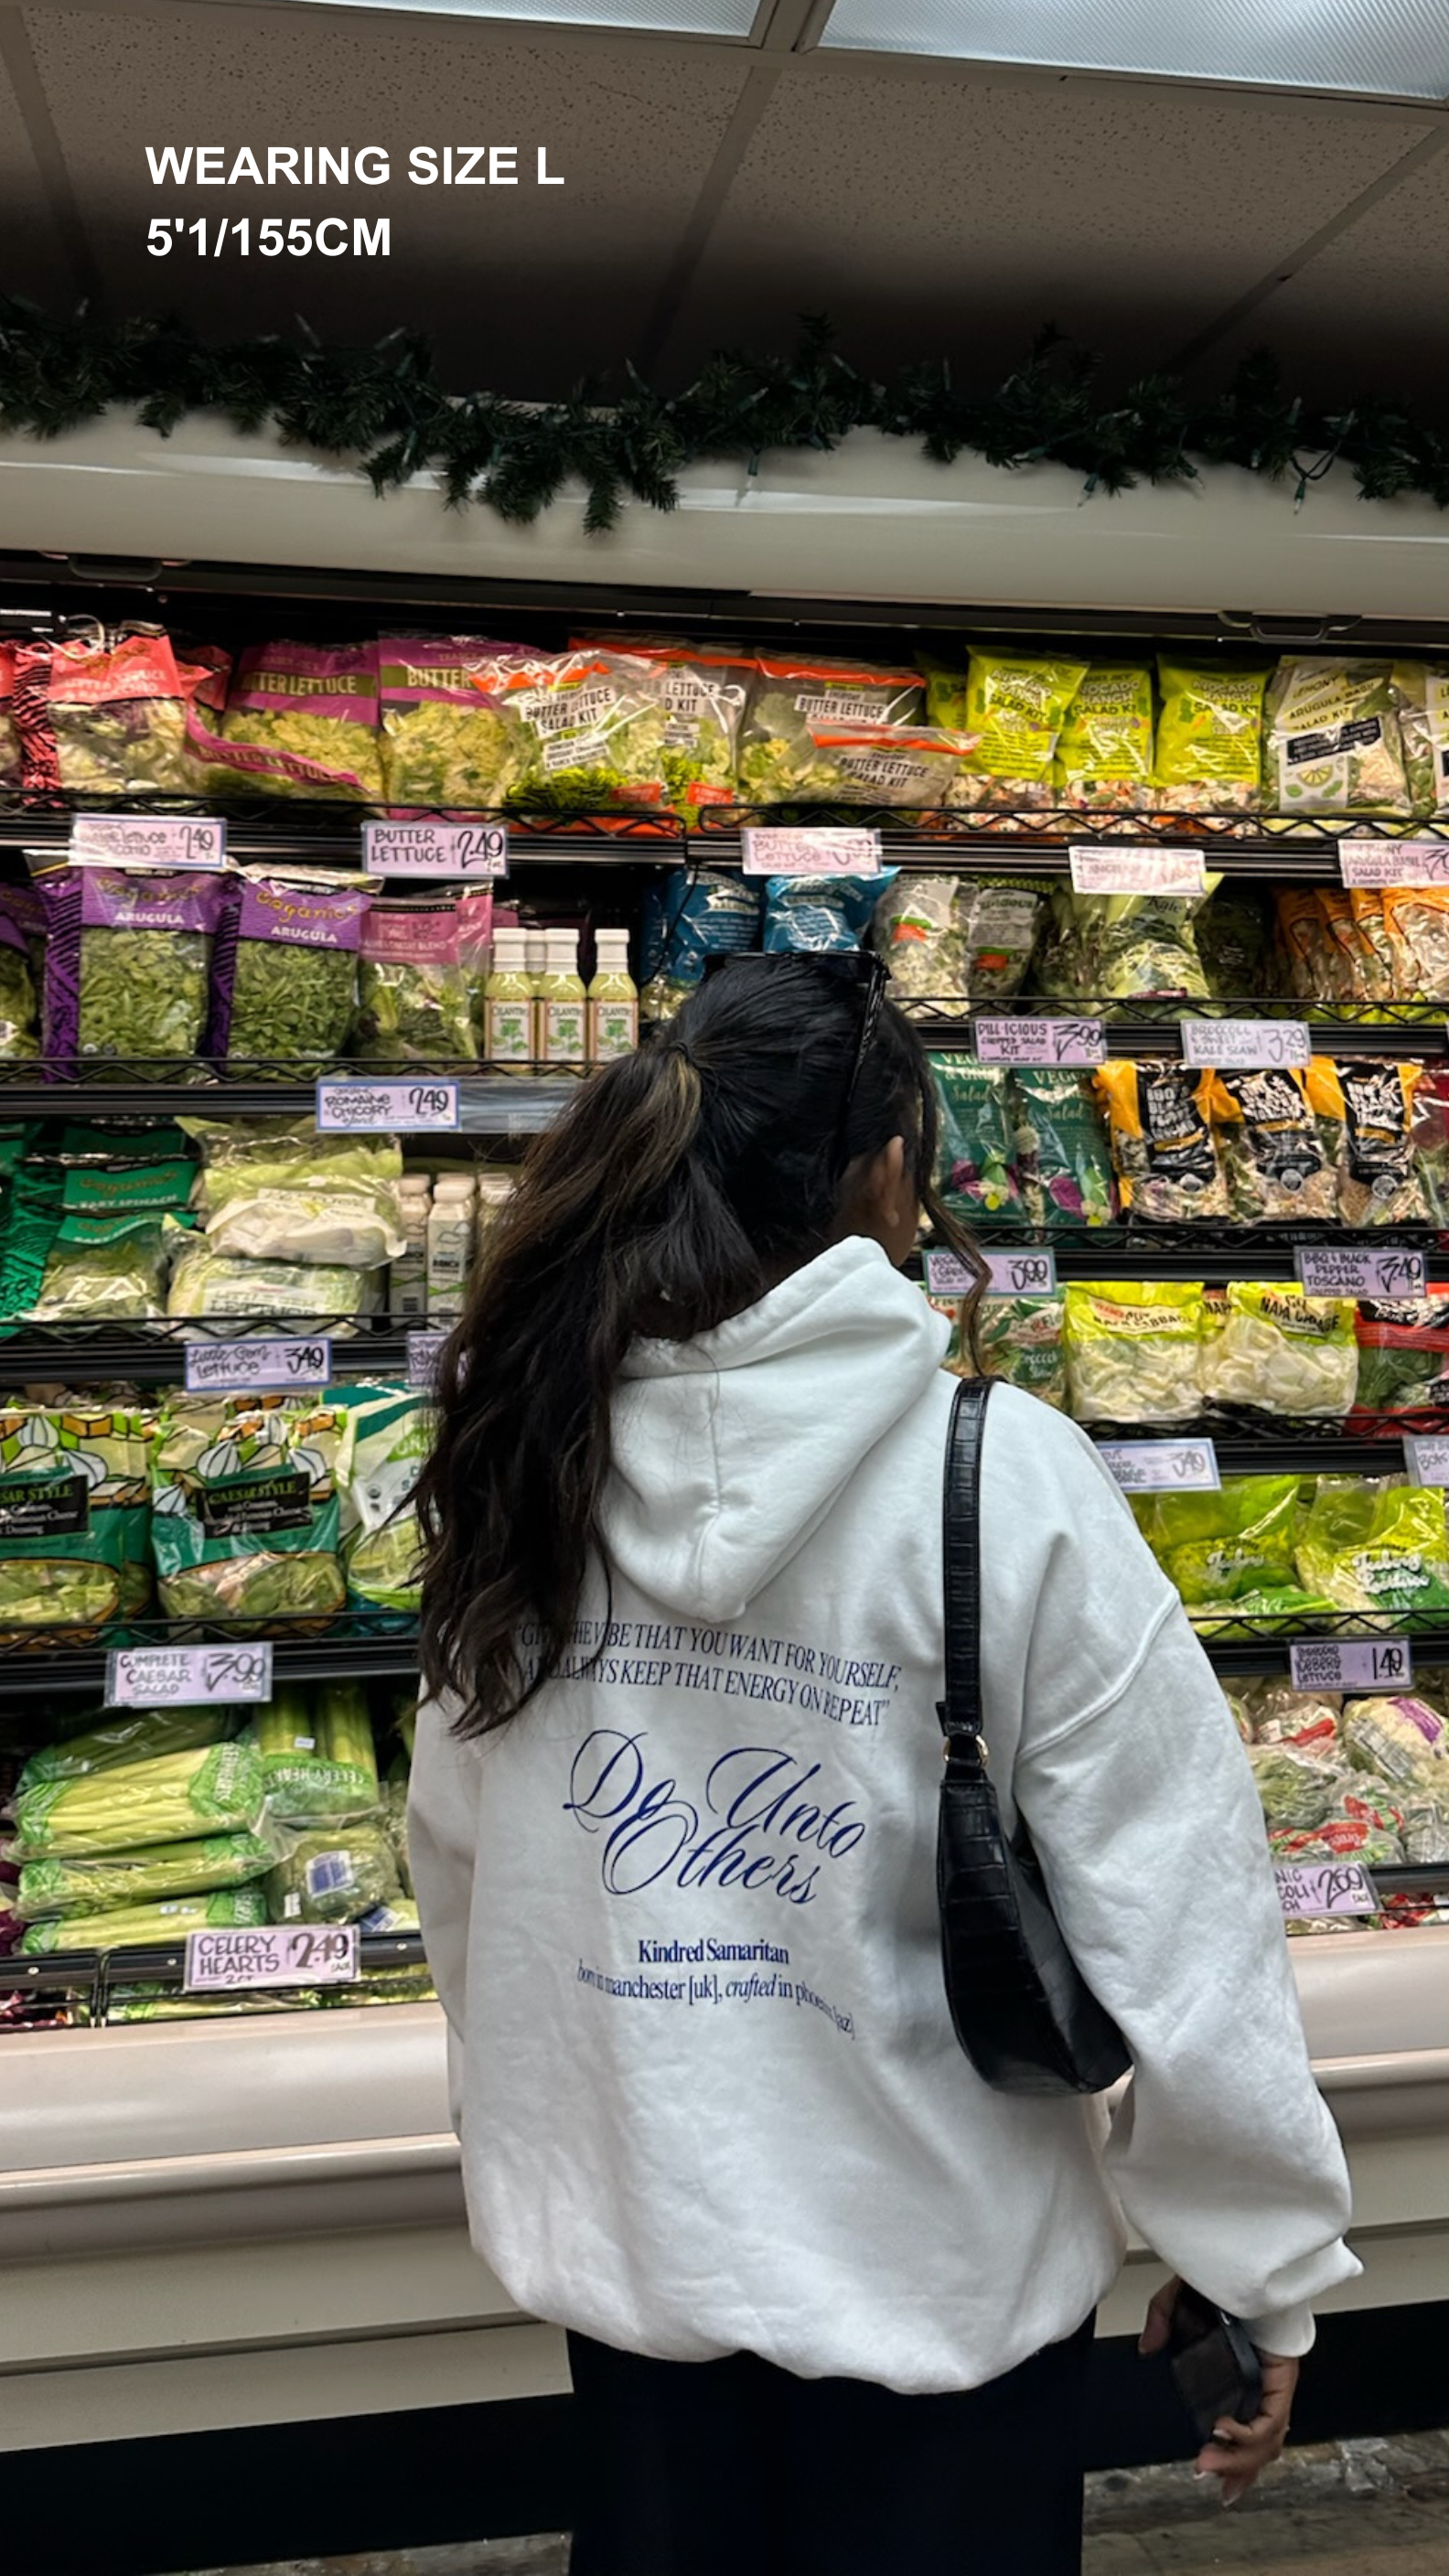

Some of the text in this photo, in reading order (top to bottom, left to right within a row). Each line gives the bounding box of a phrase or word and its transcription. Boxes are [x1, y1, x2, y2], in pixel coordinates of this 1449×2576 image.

[288, 675, 358, 695] LETTUCE
[800, 698, 837, 713] BUTTER
[374, 829, 435, 844] BUTTER
[371, 846, 447, 864] LETTUCE
[114, 911, 185, 925] ARUGULA
[270, 926, 338, 944] ARUGULA
[1306, 1275, 1366, 1287] TOSCANO
[27, 1484, 73, 1501] STYLE
[635, 1623, 687, 1651] THAT
[689, 1627, 729, 1657] YOU
[729, 1633, 785, 1665] WANT
[784, 1642, 817, 1675] FOR
[818, 1651, 902, 1695] YOURSELF,
[125, 1669, 192, 1685] CAESAR
[620, 1658, 672, 1686] KEEP
[675, 1661, 724, 1692] THAT
[723, 1669, 800, 1705] ENERGY
[799, 1683, 824, 1712] ON
[563, 1729, 866, 1859] Do Unto
[602, 1799, 821, 1905] Others
[199, 1935, 277, 1956] CELERY
[638, 1937, 790, 1965] Kindred Samaritan
[199, 1953, 280, 1975] HEARTS
[604, 1974, 687, 2001] manchester
[688, 1973, 724, 2005] [uk],
[724, 1972, 778, 2003] crafted
[778, 1973, 793, 1999] in
